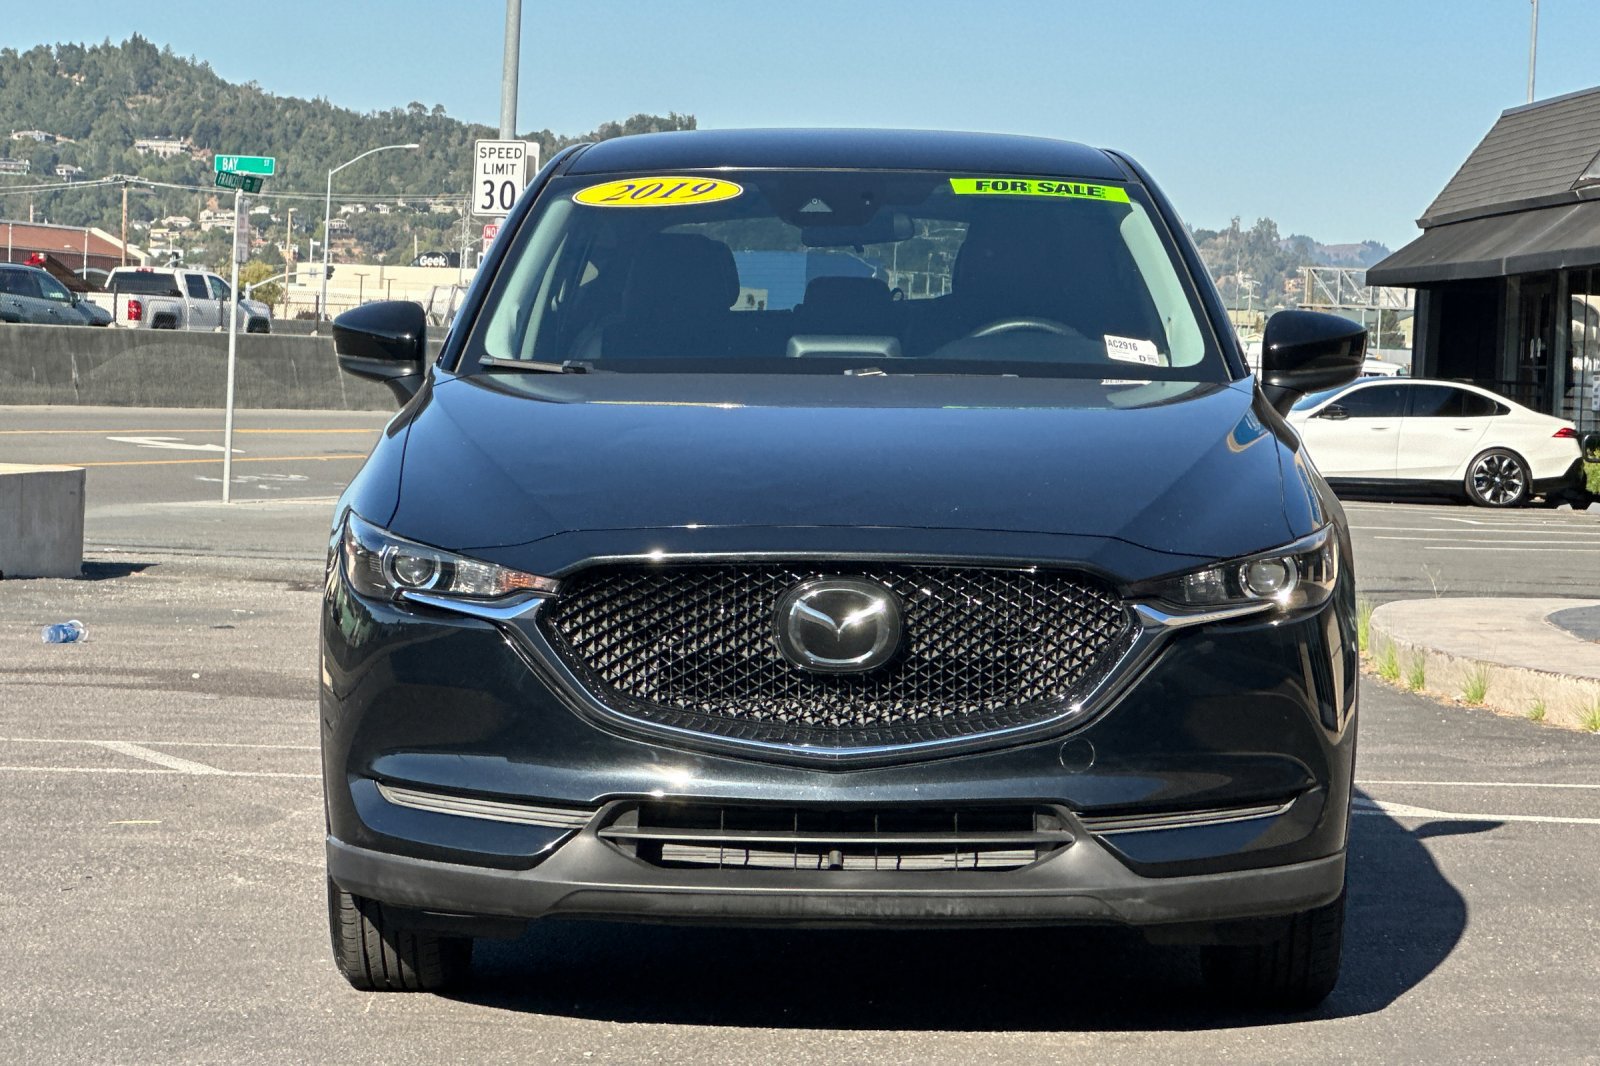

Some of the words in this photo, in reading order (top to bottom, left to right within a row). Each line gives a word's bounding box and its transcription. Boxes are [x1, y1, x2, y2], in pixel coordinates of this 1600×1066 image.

[480, 147, 522, 159] SPEED
[222, 157, 239, 171] BAY
[483, 163, 517, 175] LIMIT
[481, 180, 516, 211] 30
[600, 182, 717, 202] 2019
[976, 180, 1029, 192] FOR
[1038, 182, 1103, 198] SALE
[419, 256, 446, 267] Geek
[1108, 340, 1138, 351] AC2916
